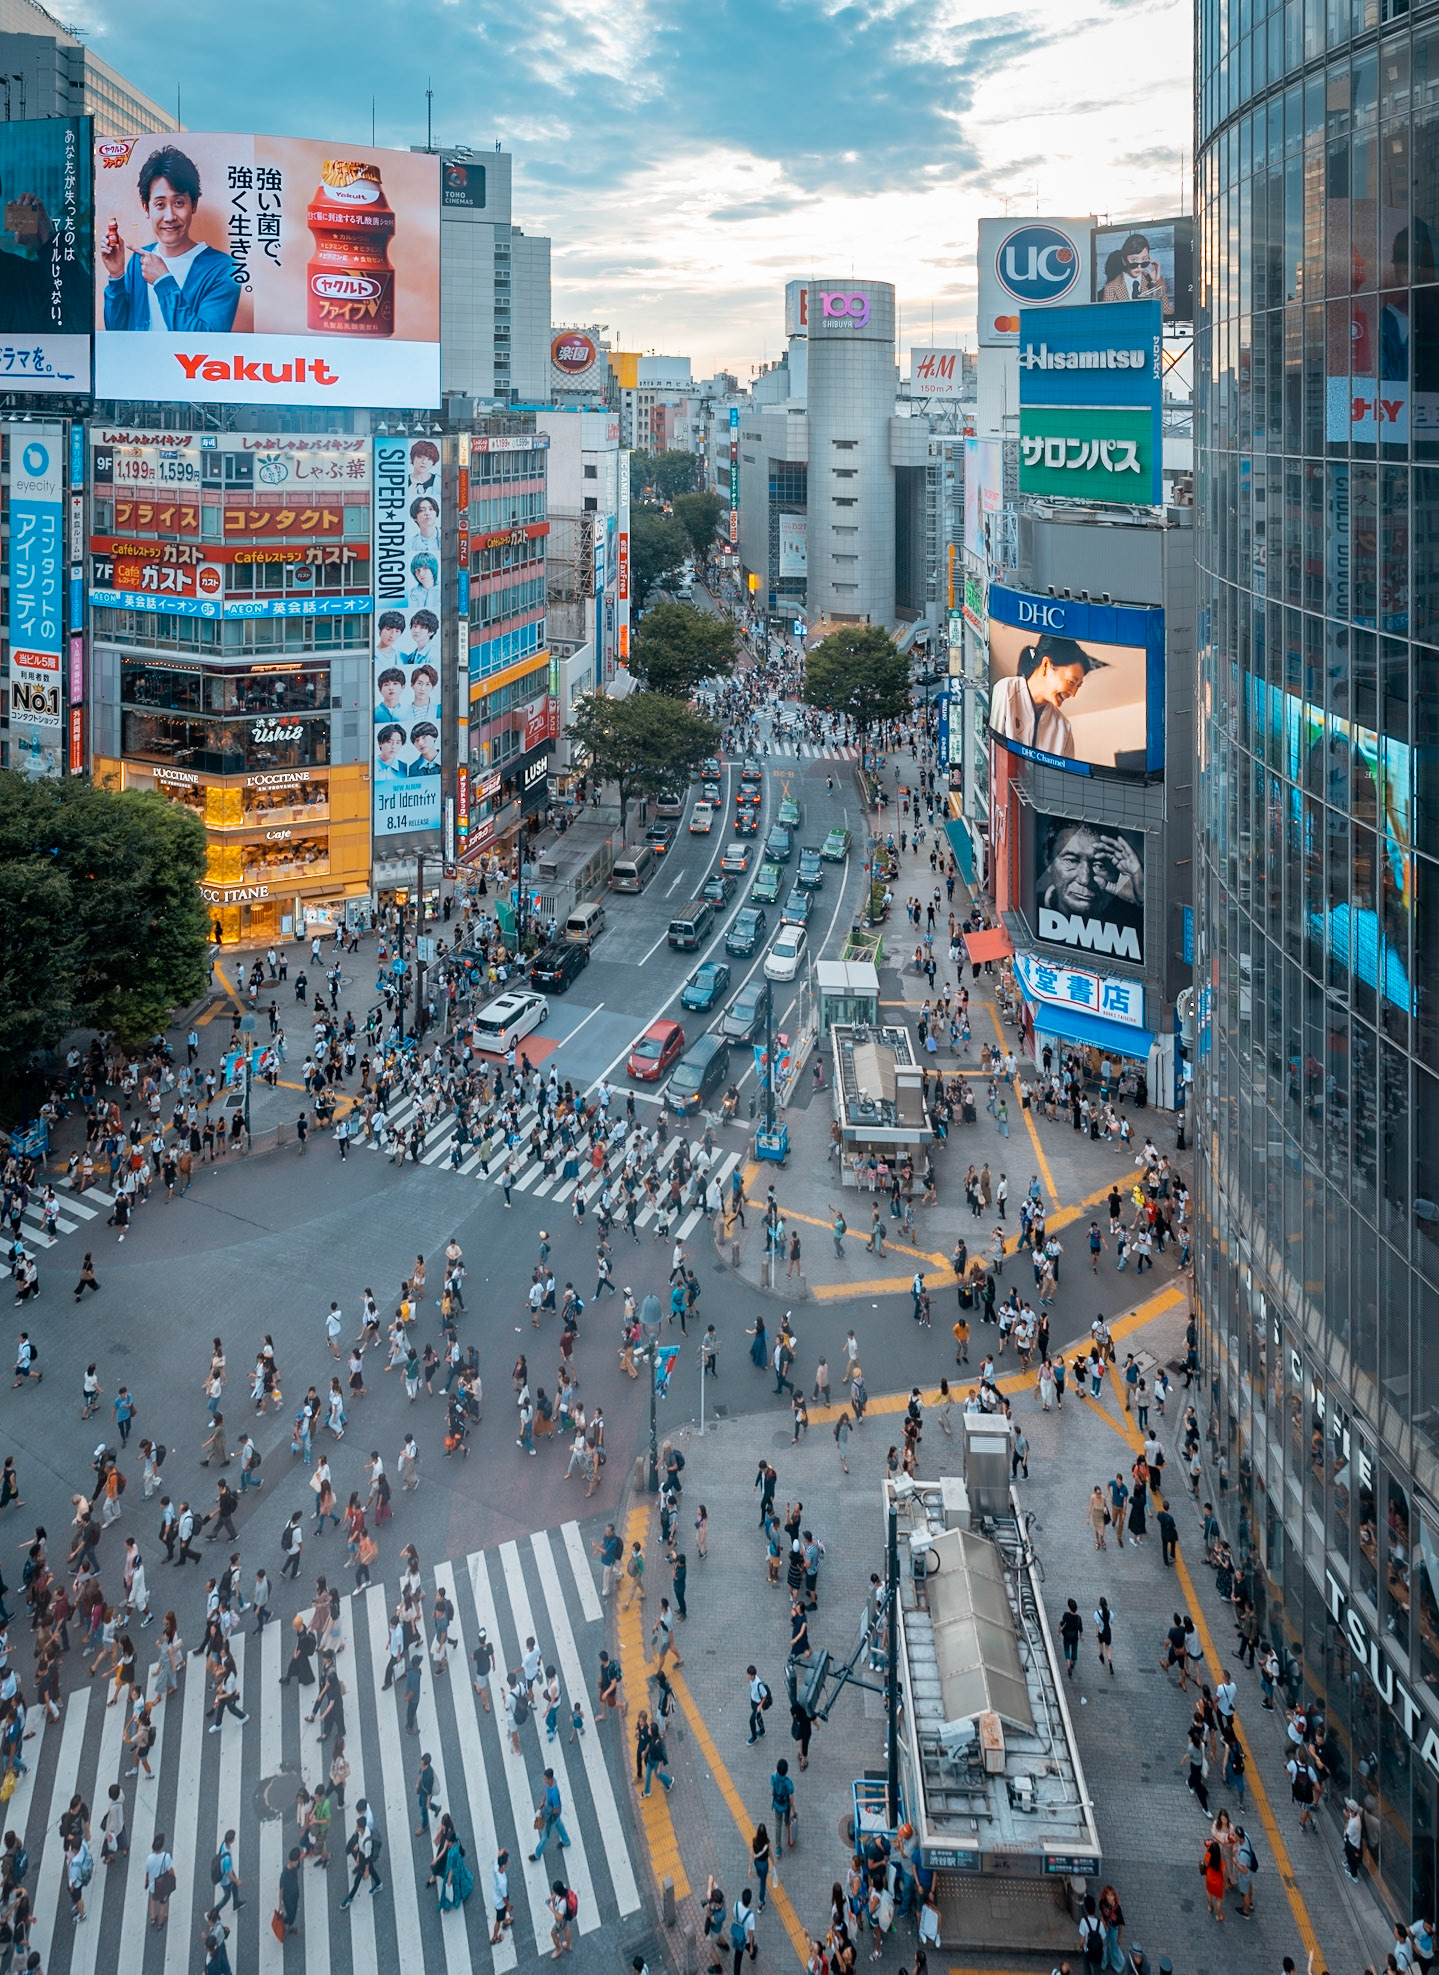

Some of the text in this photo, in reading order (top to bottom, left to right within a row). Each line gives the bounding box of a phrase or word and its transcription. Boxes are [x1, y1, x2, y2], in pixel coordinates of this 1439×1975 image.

[64, 129, 76, 261] あなたが失ったのは
[336, 191, 367, 200] Yakult
[445, 191, 466, 199] TOHO
[257, 166, 282, 268] 強い菌で、
[228, 166, 254, 293] 強く生きる。
[51, 218, 63, 326] マイルじゃない。
[321, 279, 368, 295] ヤクルト
[319, 300, 371, 321] ファイブ
[819, 292, 871, 329] 109
[822, 320, 853, 329] SHIBUYA
[0, 347, 52, 372] ラマを。
[1016, 343, 1145, 369] Hisamitsu
[1152, 336, 1161, 380] サロンパス
[175, 353, 339, 386] Yakult
[917, 354, 957, 380] H&M
[102, 432, 192, 447] しゃぶしゃぶバイキング
[242, 438, 365, 451] しゃぶしゃぶバイキング
[97, 457, 113, 470] 9F
[1021, 435, 1140, 474] サロンパス
[295, 458, 366, 480] しゃぶ葉
[17, 480, 55, 494] eyecity
[620, 454, 628, 507] BIC CAMERA
[116, 504, 198, 528] プライス
[225, 509, 339, 530] コンタクト
[378, 448, 405, 600] SUPER DRAGON
[510, 529, 529, 546] ガスト
[163, 544, 204, 565] ガスト
[305, 546, 358, 565] ガスト
[460, 540, 468, 561] ガスト
[17, 513, 36, 637] アイシティ
[41, 515, 56, 639] コンタクトの
[95, 563, 114, 579] 7F
[141, 564, 193, 592] ガスト
[201, 578, 219, 587] ガスト
[94, 591, 117, 602] AEON
[124, 594, 197, 613] 英会話イーオン
[230, 604, 262, 614] AEON
[272, 600, 370, 615] 英会話イーオン
[1018, 600, 1066, 629] DHC
[19, 653, 57, 669] 当ビル5階
[21, 670, 50, 683] 利用者数
[12, 680, 60, 716] No.1
[11, 711, 59, 726] コンタクトショップ
[251, 725, 304, 743] Ushi8
[1021, 747, 1066, 768] DHC Channel
[524, 755, 548, 786] LUSH
[379, 794, 395, 811] 3rd
[387, 815, 430, 829] 8.14 RELEASE
[1039, 907, 1142, 960] DMM
[1103, 1010, 1117, 1019] BOOKS
